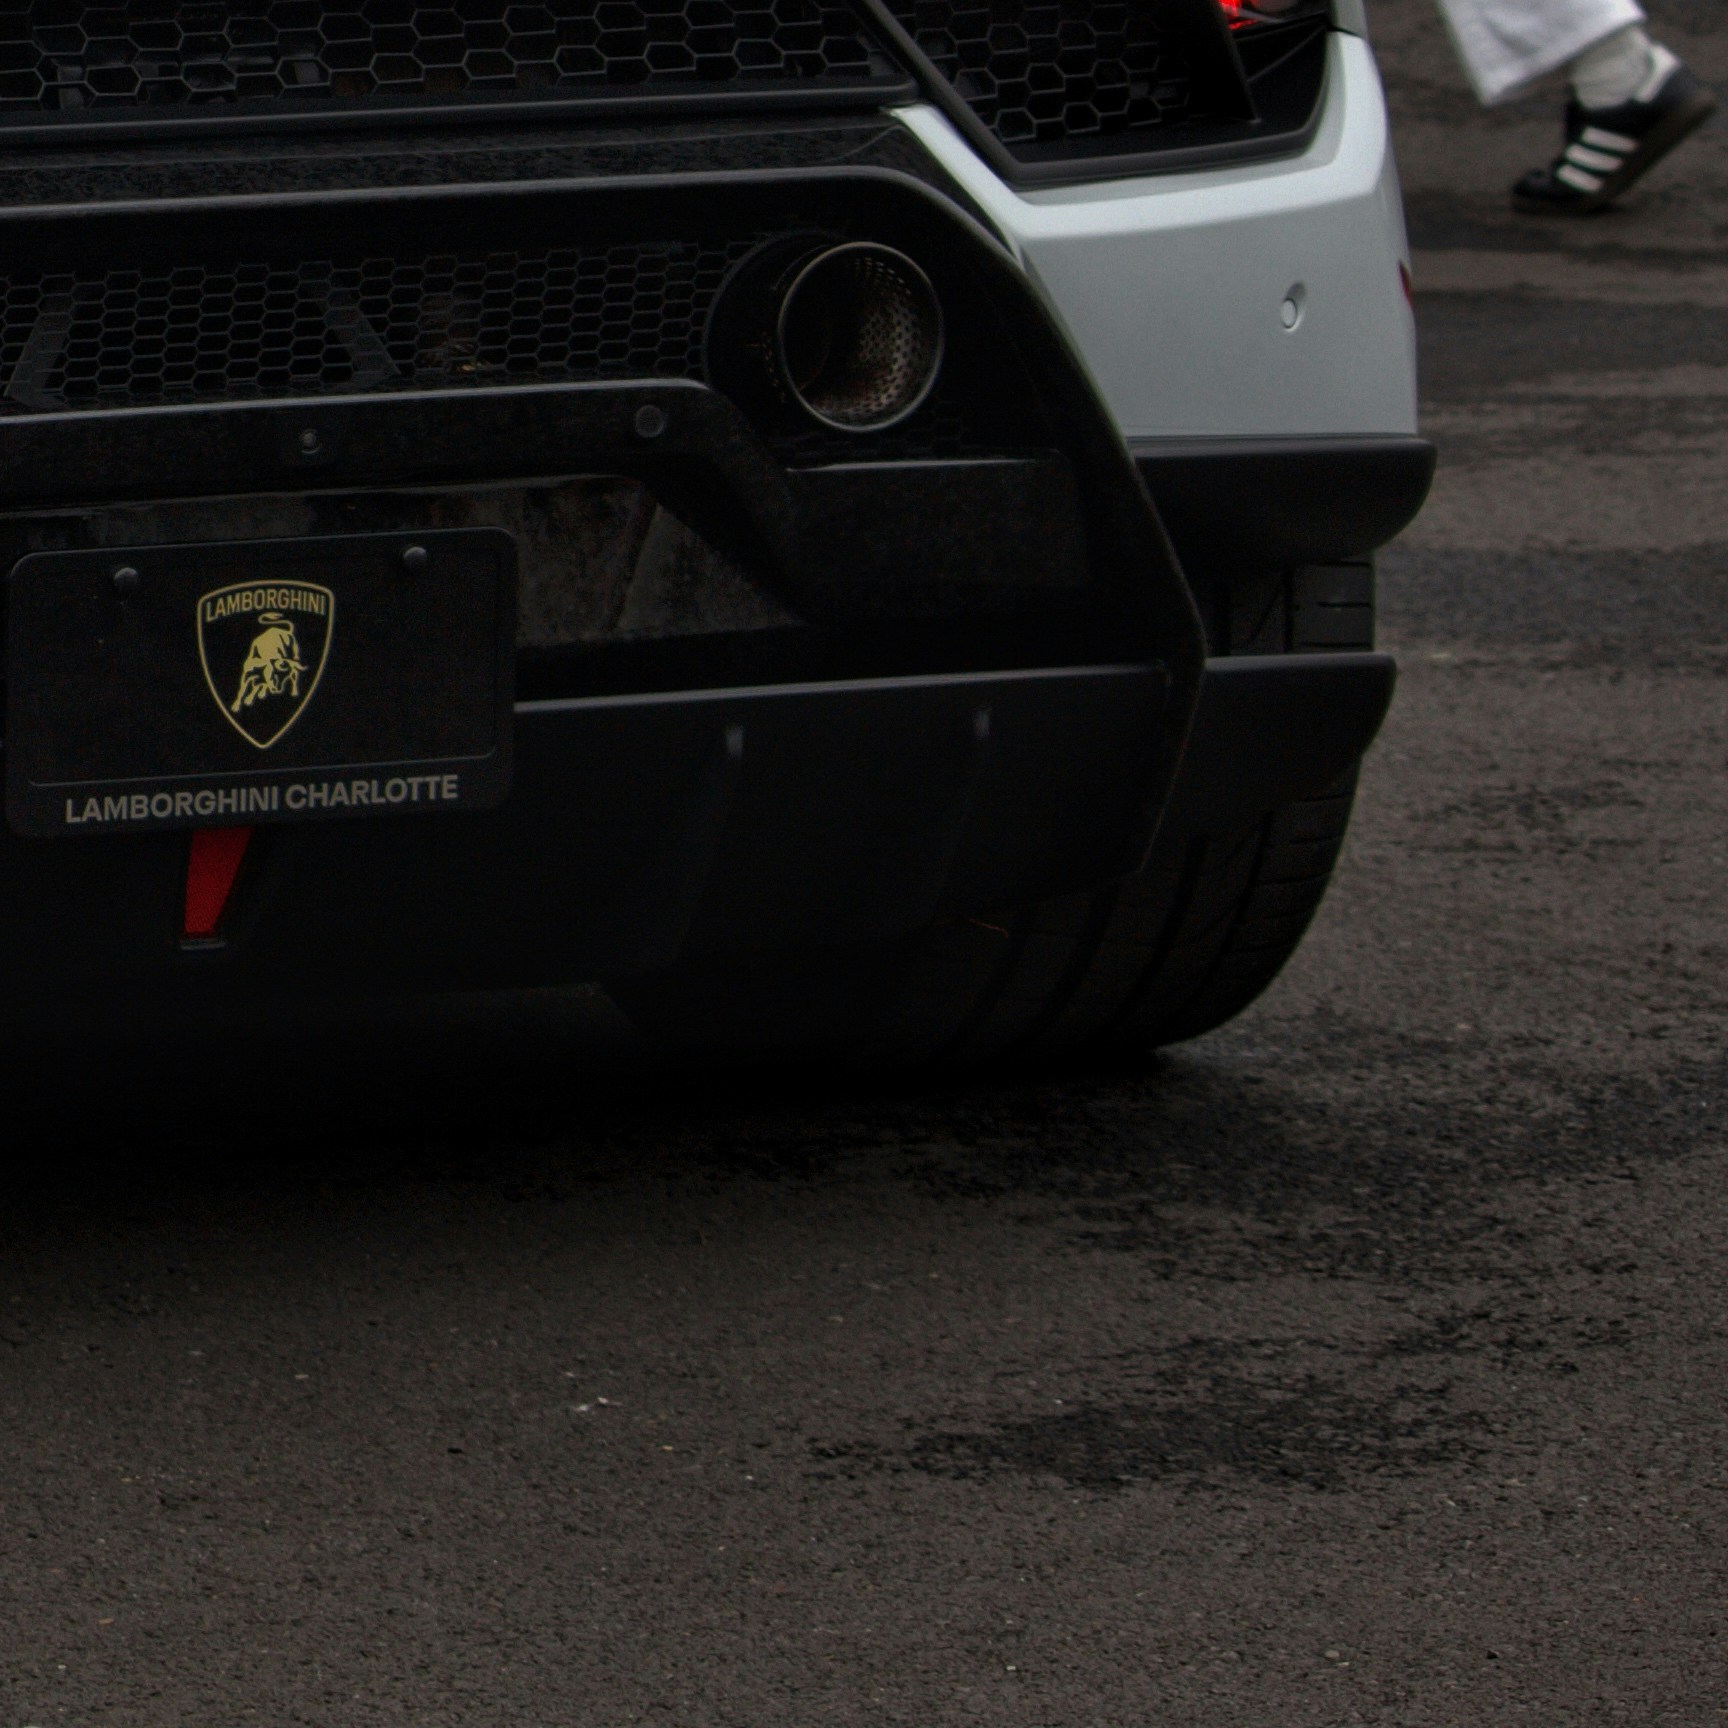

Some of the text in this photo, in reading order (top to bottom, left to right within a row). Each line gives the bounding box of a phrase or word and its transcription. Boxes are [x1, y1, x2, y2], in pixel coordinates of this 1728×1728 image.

[205, 588, 326, 624] LAMBORGHINI
[65, 775, 459, 824] LAMBORGHINI CHARLOTTE
